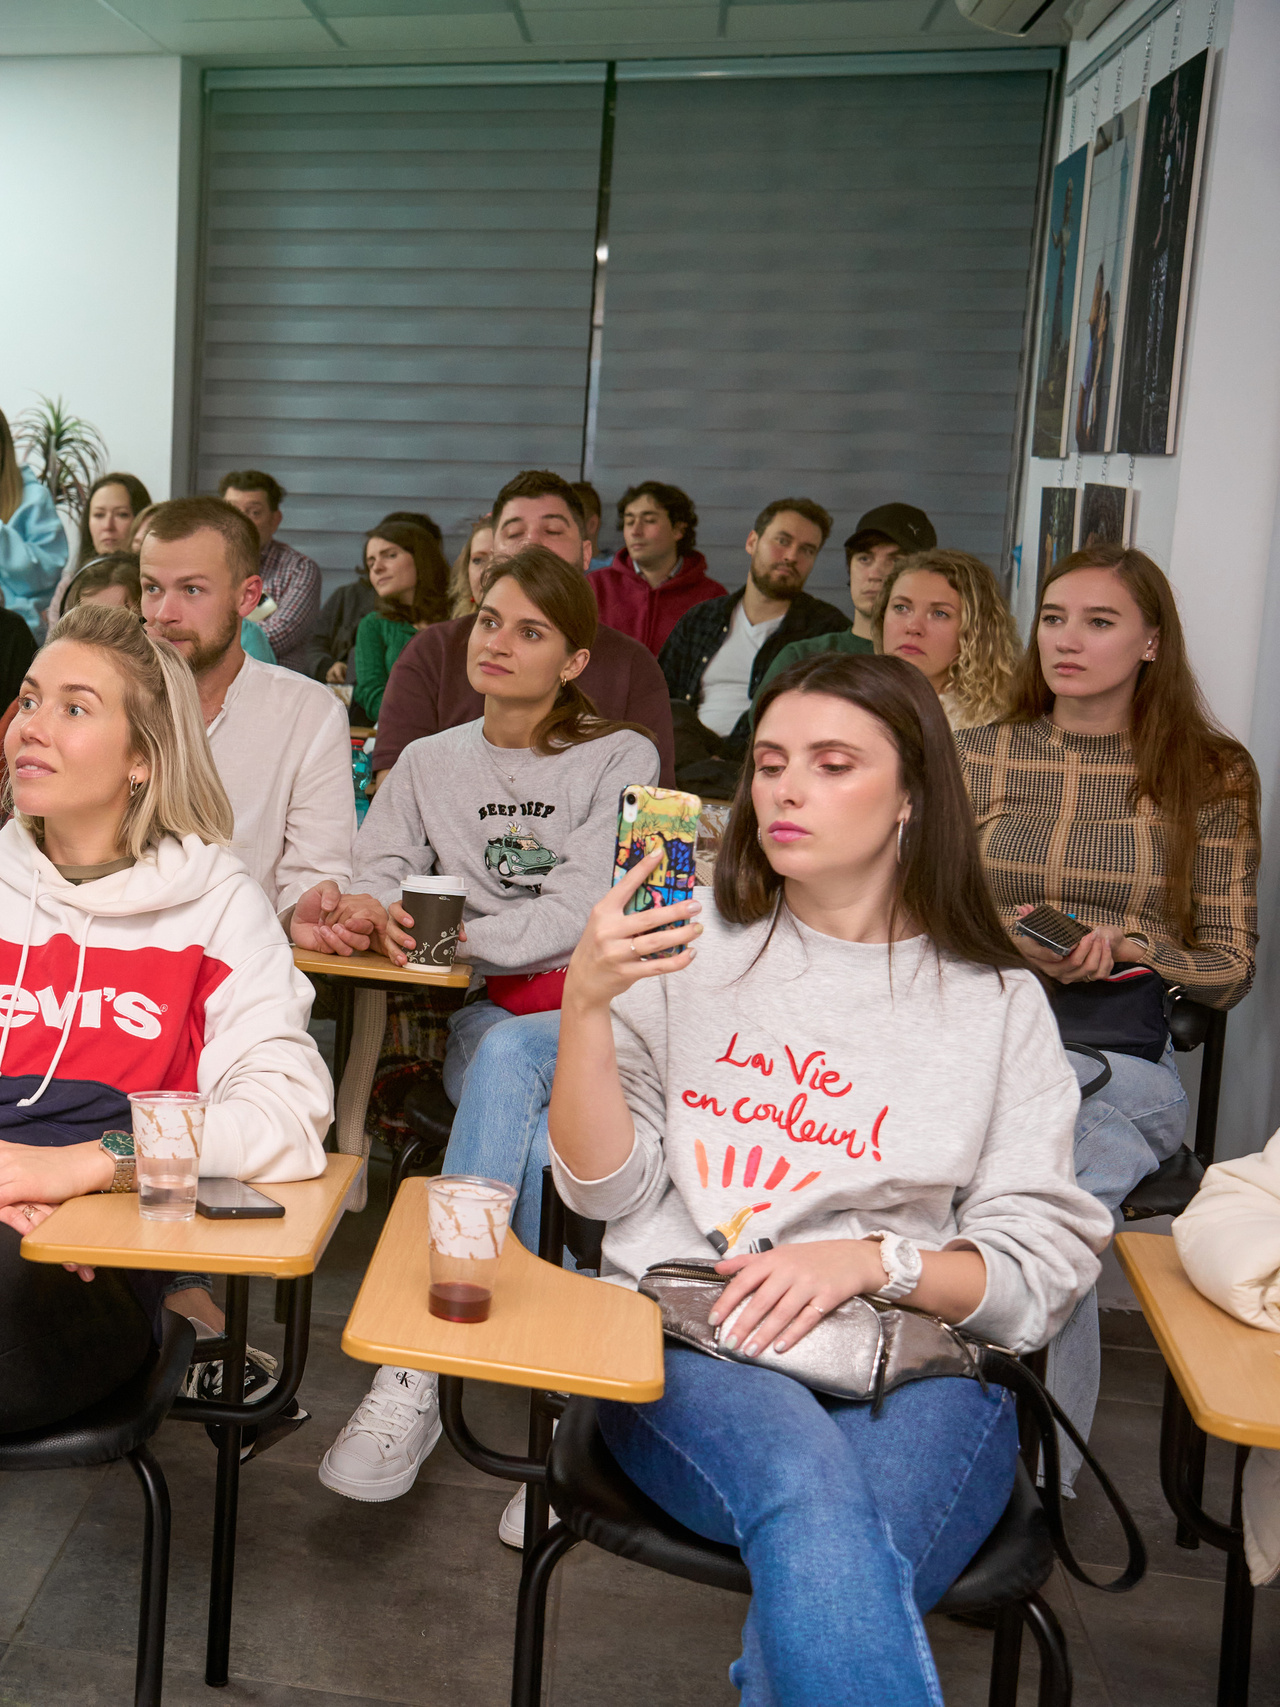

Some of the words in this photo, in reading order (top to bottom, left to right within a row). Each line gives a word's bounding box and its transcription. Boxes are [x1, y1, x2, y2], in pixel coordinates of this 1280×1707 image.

[478, 803, 517, 820] BEEP
[715, 1032, 774, 1076] La
[784, 1044, 853, 1097] Vie
[681, 1089, 727, 1116] en
